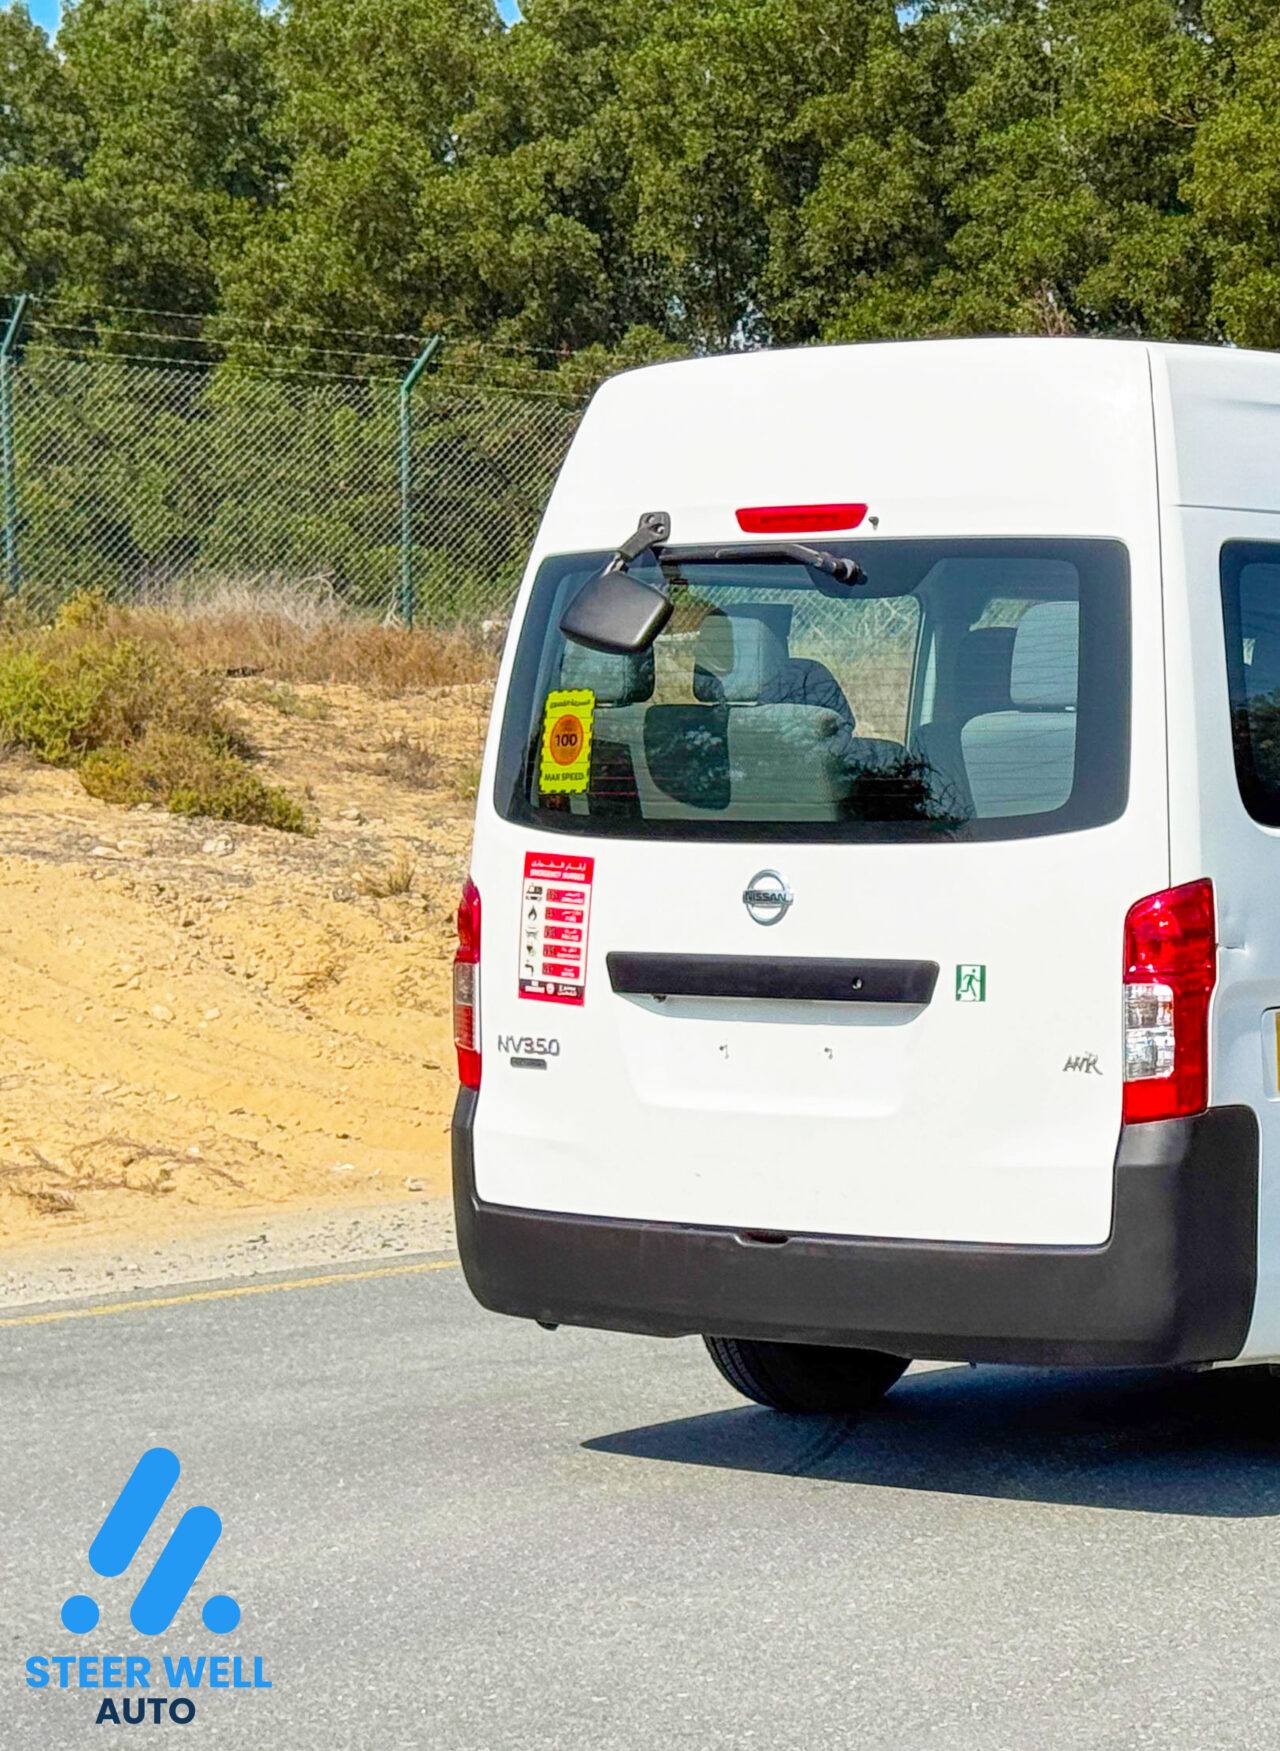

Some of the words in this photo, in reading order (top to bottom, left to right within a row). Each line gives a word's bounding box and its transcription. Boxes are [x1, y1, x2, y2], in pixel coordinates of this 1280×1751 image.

[556, 734, 578, 747] 100
[561, 772, 585, 781] SPEED
[745, 891, 787, 902] NISSAN
[498, 1034, 560, 1056] NV350
